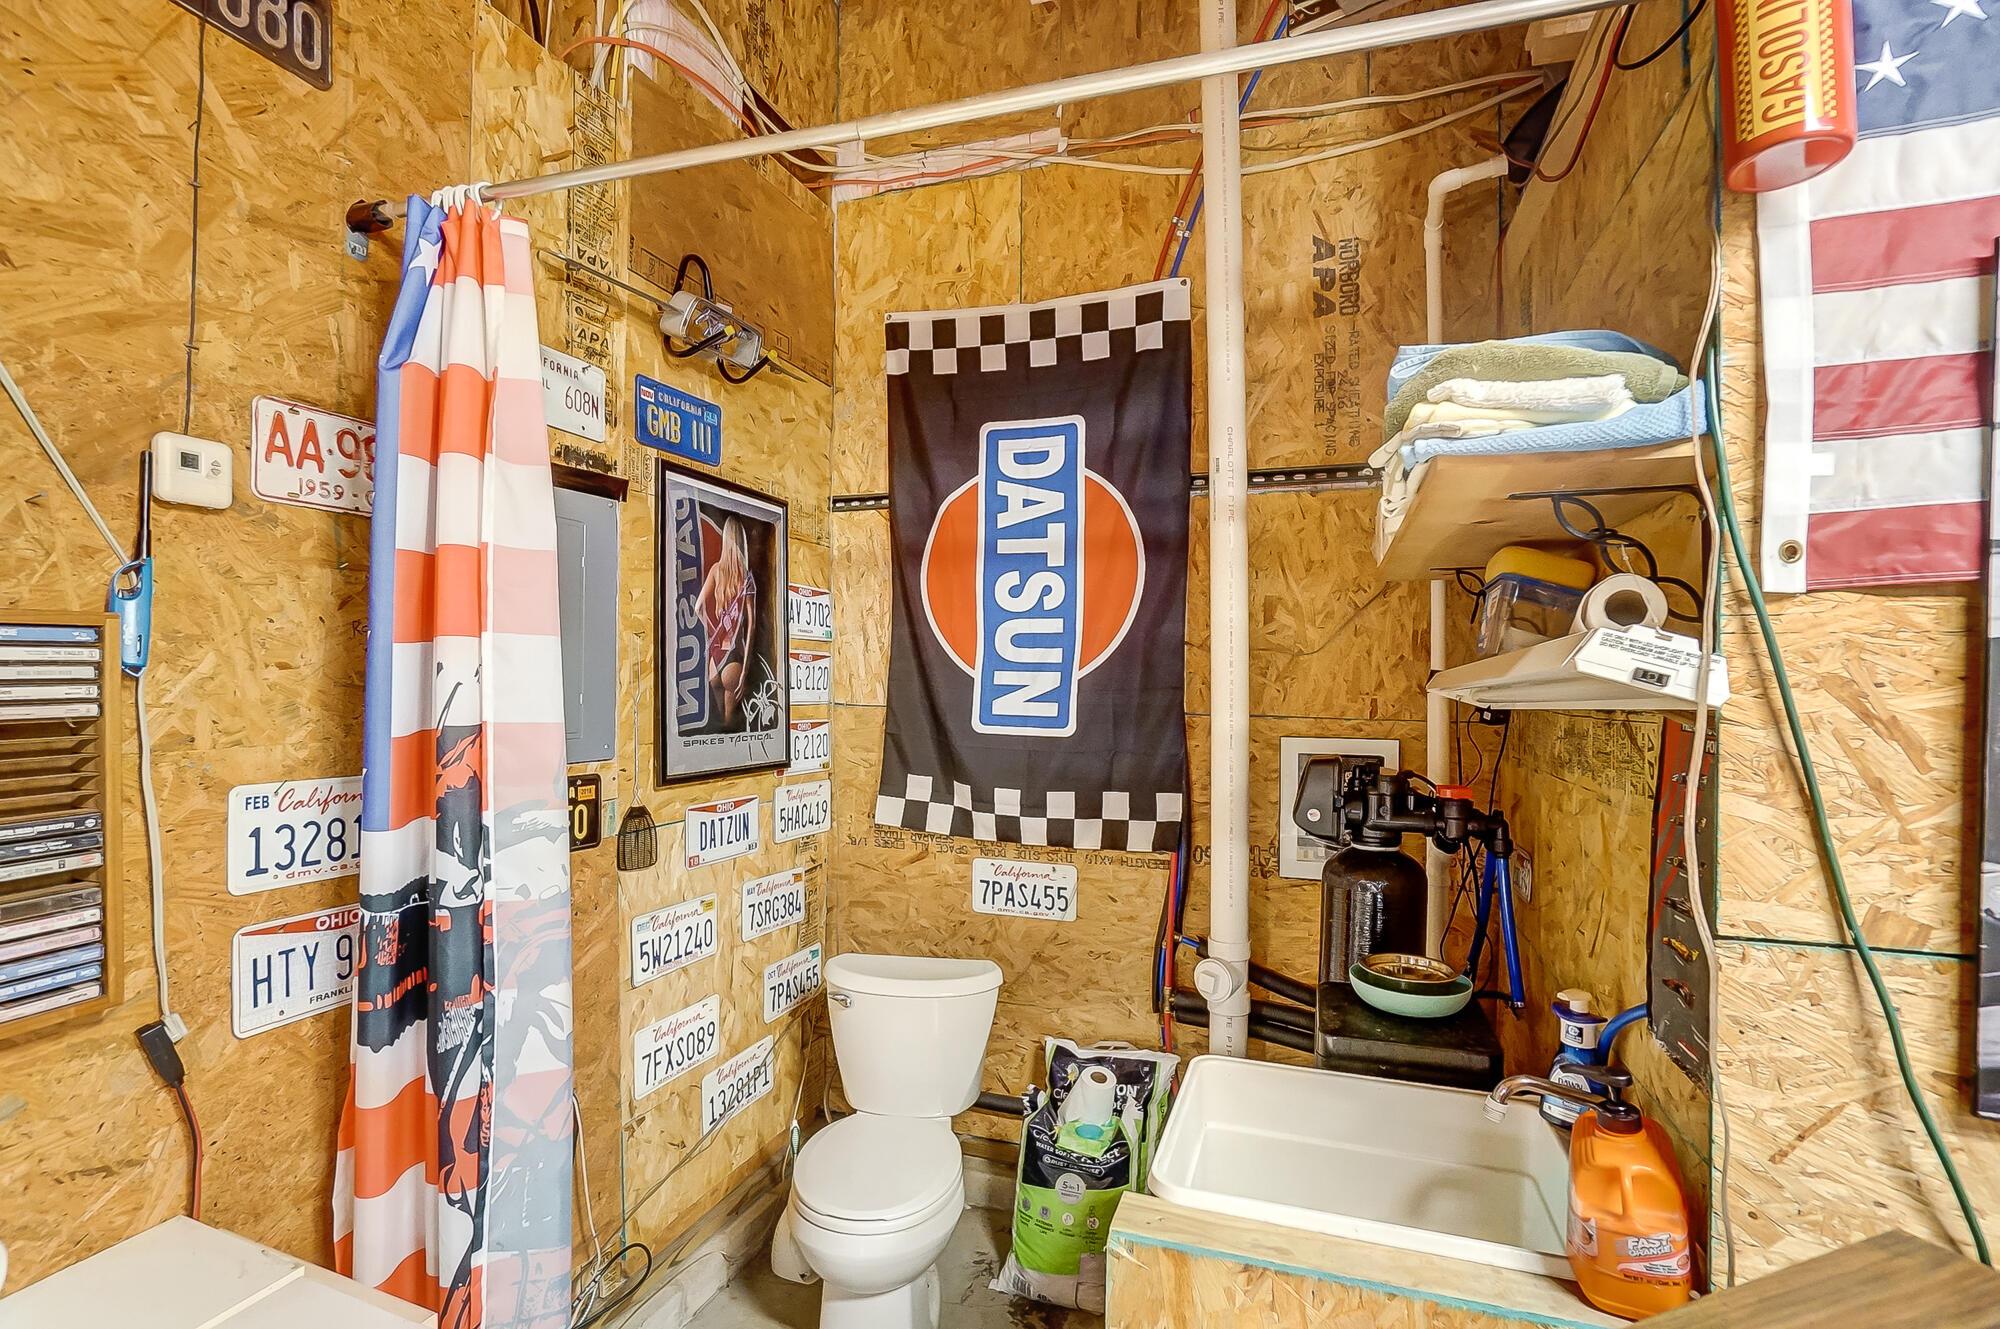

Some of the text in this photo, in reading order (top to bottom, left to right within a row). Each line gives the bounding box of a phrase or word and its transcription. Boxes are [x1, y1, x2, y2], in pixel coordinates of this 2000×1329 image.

[1312, 235, 1336, 318] APA
[578, 327, 609, 351] APA
[543, 357, 579, 381] FORNIA
[565, 386, 599, 420] 608N
[658, 391, 702, 418] CALIFORNIA
[646, 404, 682, 445] GMB
[992, 434, 1066, 717] DATSUN
[805, 600, 832, 628] 3702
[805, 666, 829, 690] 2120
[683, 733, 774, 748] SPIKES TACTICAL
[798, 723, 811, 731] OHIO
[804, 733, 828, 759] 2120
[245, 785, 362, 815] FEB Californ
[716, 801, 735, 813] OHIO
[780, 799, 828, 834] 5HAC419
[700, 812, 750, 852] DATZUN
[936, 842, 968, 855] SPACE
[286, 861, 361, 879] dmv.ca.g
[993, 864, 1055, 882] California
[980, 880, 1068, 912] 7PAS455
[316, 911, 360, 931] OHIO
[651, 908, 704, 933] California
[748, 889, 802, 931] 7SRG384
[640, 918, 713, 973] 5W21240
[252, 941, 320, 1009] HTY
[769, 964, 819, 1012] 7PAS455
[309, 985, 353, 1004] FRANKL
[653, 1012, 705, 1043] California
[642, 1021, 716, 1086] 7FXS089
[716, 1052, 760, 1085] California
[1035, 1141, 1054, 1153] WATER
[1627, 1233, 1671, 1250] FAST
[1628, 1246, 1672, 1257] ORANGE
